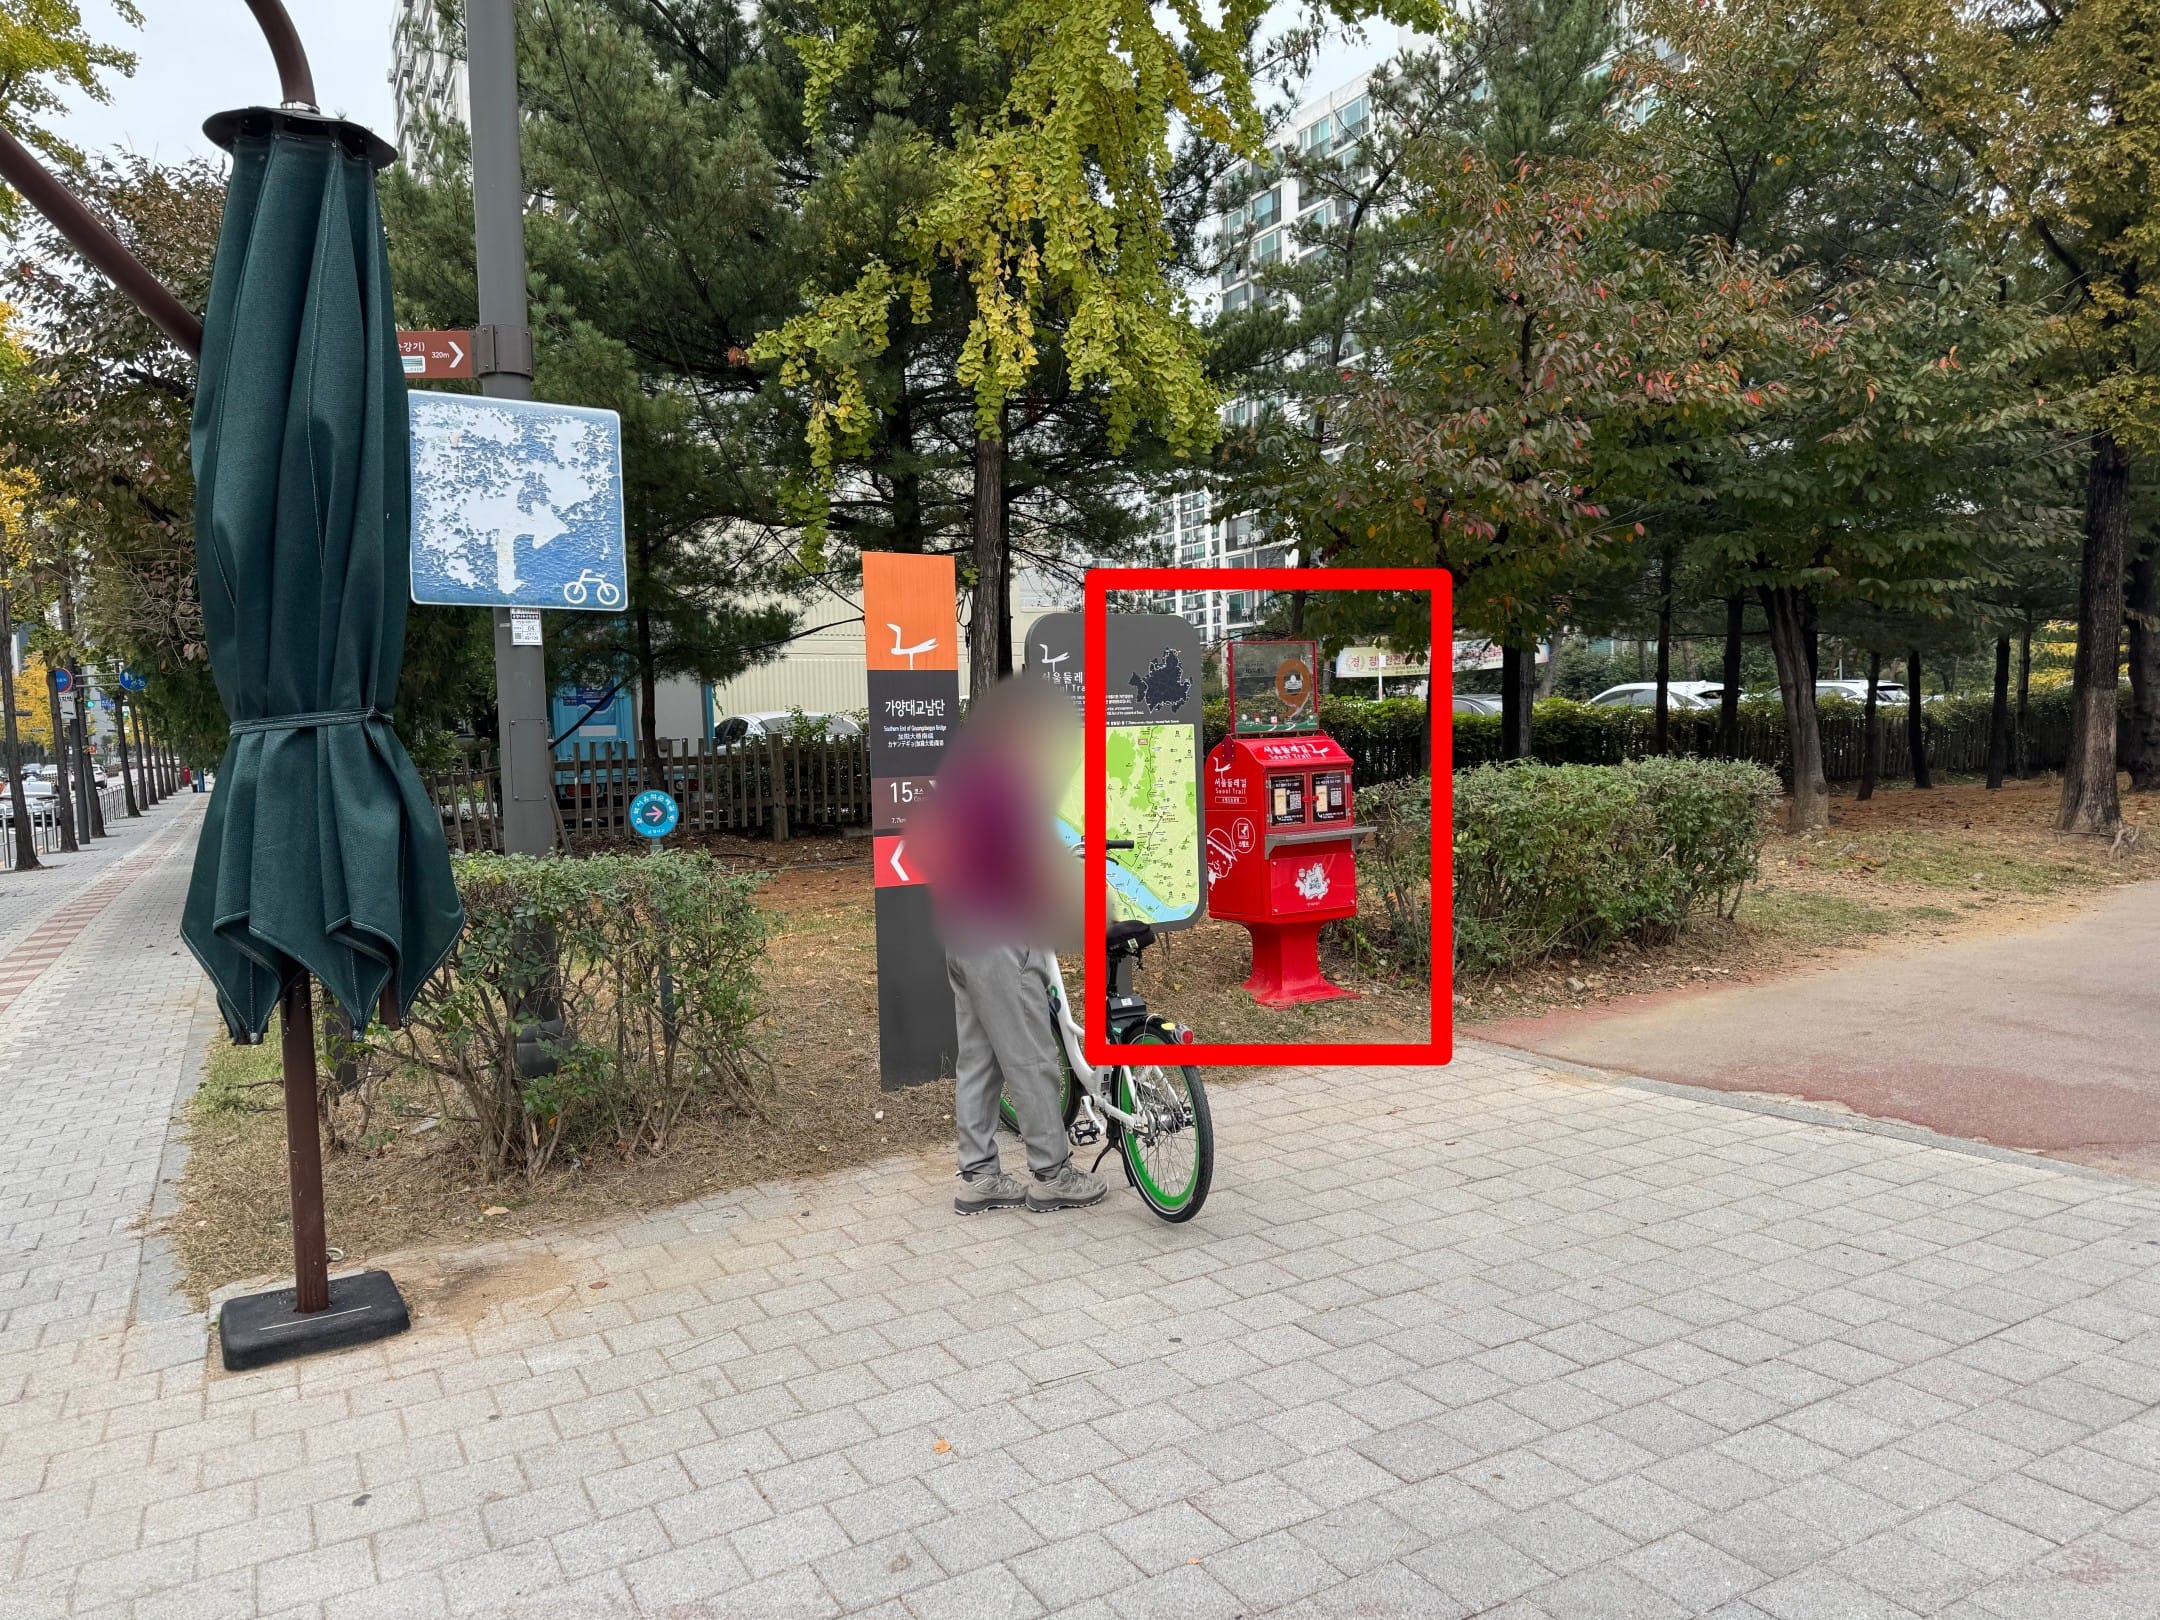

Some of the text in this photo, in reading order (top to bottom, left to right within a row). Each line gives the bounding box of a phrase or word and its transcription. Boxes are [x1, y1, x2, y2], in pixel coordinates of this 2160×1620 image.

[431, 351, 450, 359] 320m
[1041, 671, 1083, 684] 서울둘레
[885, 699, 946, 717] 가양대교남단
[1214, 778, 1247, 788] 서울둘레길
[890, 782, 913, 804] 15
[1215, 787, 1231, 795] Seoul
